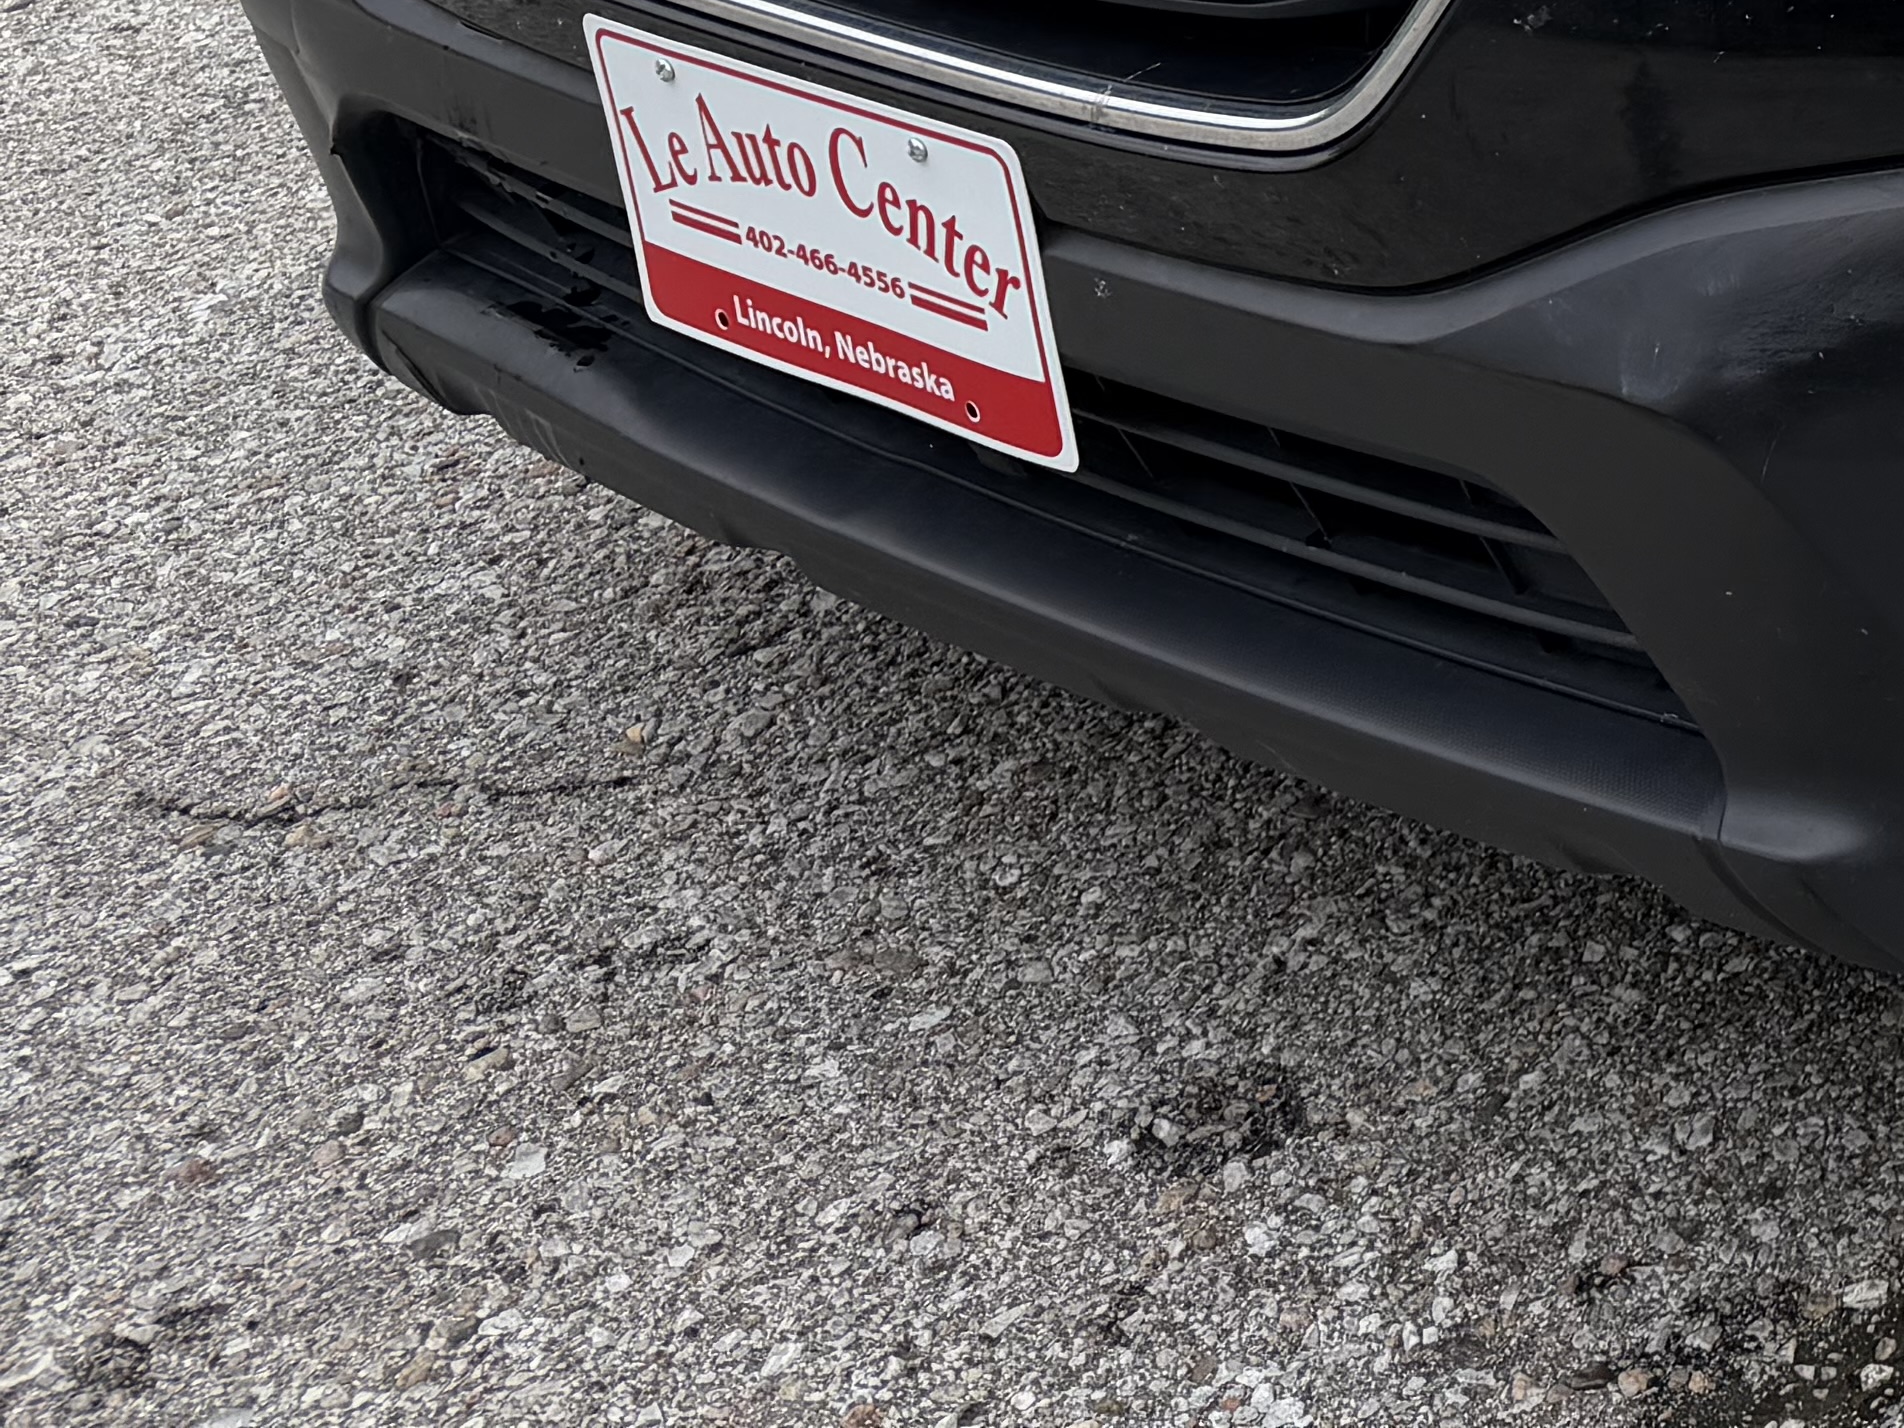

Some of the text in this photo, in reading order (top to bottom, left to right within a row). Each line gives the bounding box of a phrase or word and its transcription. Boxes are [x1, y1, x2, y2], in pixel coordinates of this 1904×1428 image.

[620, 93, 1020, 320] Le Auto Center
[746, 225, 906, 300] 402-466-4556
[733, 295, 956, 402] Lincoln, Nebraska
